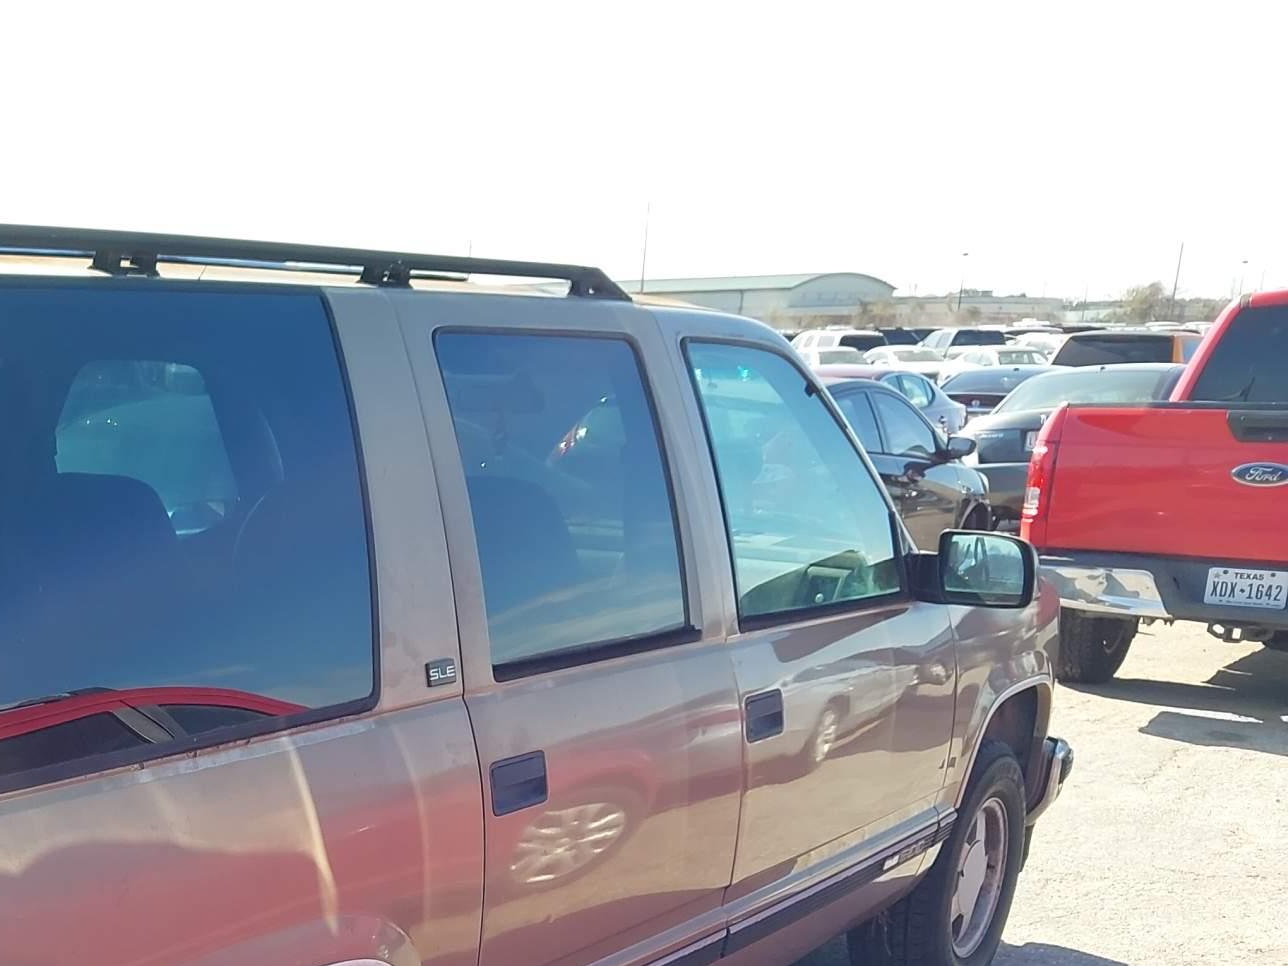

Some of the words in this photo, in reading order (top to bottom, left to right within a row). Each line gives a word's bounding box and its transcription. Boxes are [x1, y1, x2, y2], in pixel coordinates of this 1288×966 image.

[1245, 466, 1282, 481] Ford
[1234, 572, 1265, 581] TEXAS
[429, 665, 456, 681] SLE
